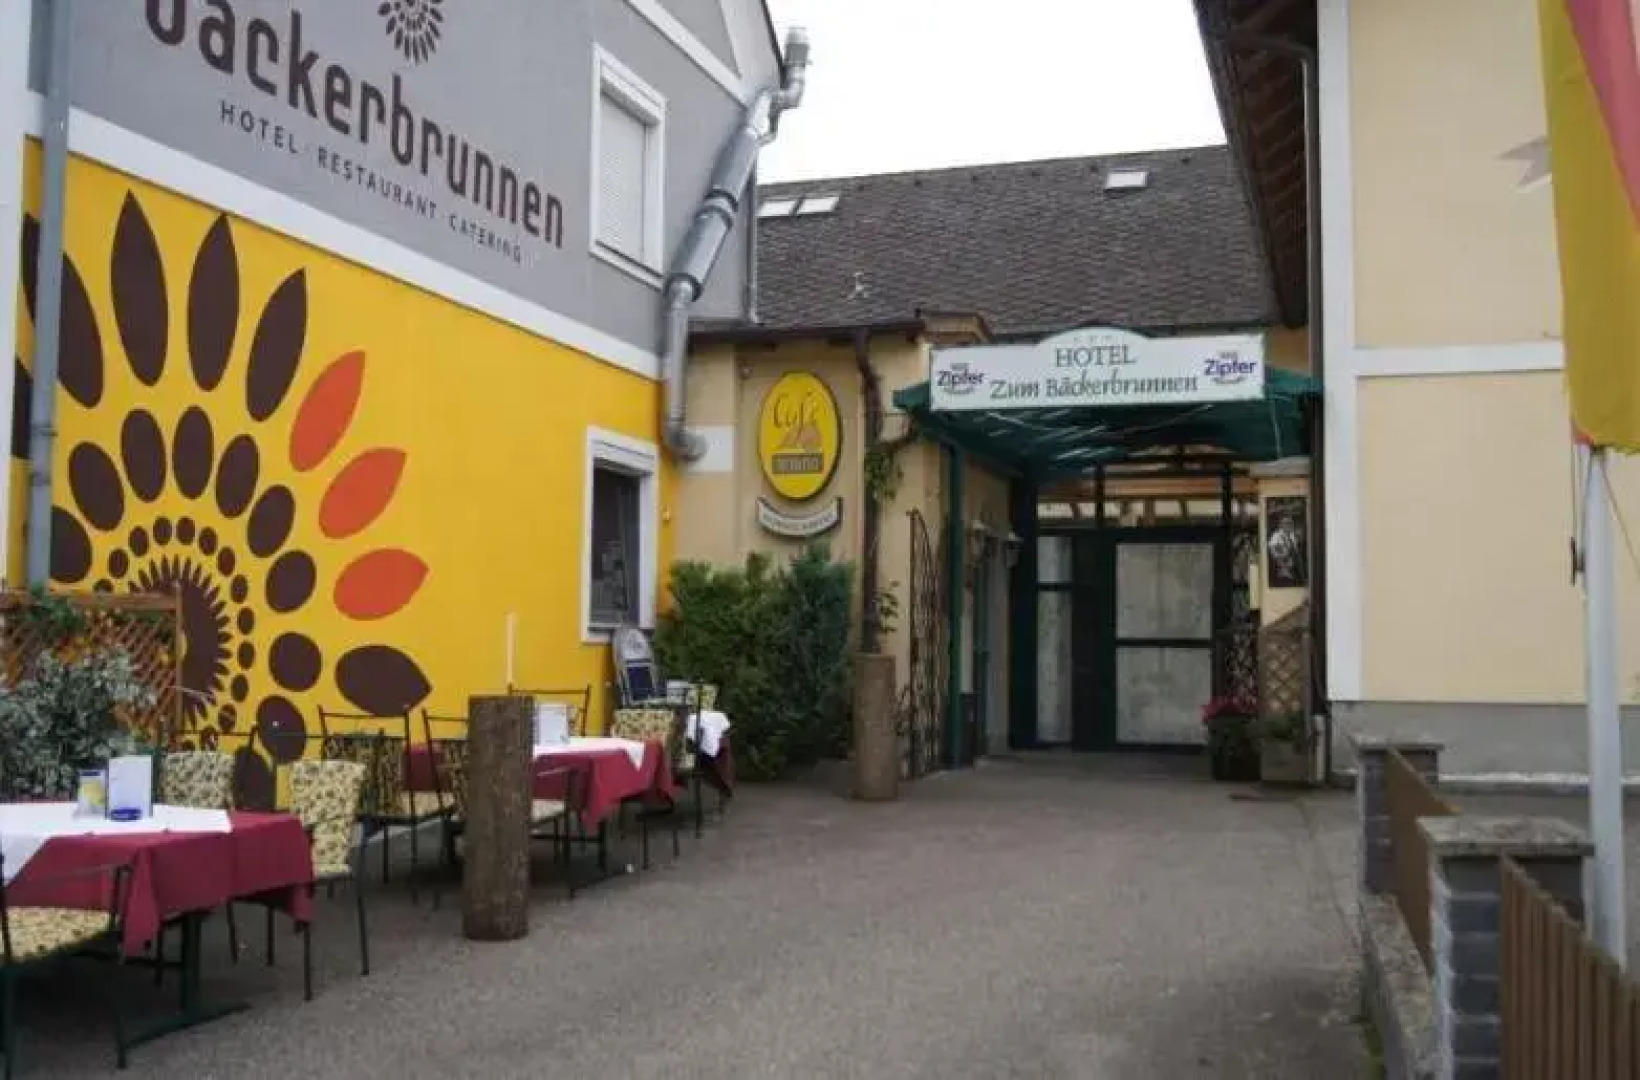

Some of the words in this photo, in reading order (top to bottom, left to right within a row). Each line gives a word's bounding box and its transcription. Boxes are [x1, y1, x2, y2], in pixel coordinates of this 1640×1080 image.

[220, 100, 299, 154] HOTEL
[318, 146, 437, 219] RESTAURANT
[449, 213, 521, 264] CATERING
[1056, 345, 1137, 368] HOTEL
[1204, 359, 1257, 377] Zipfer
[937, 369, 985, 388] Zipfer
[990, 379, 1039, 399] Zum
[1046, 369, 1198, 397] Bäckerbrunnen
